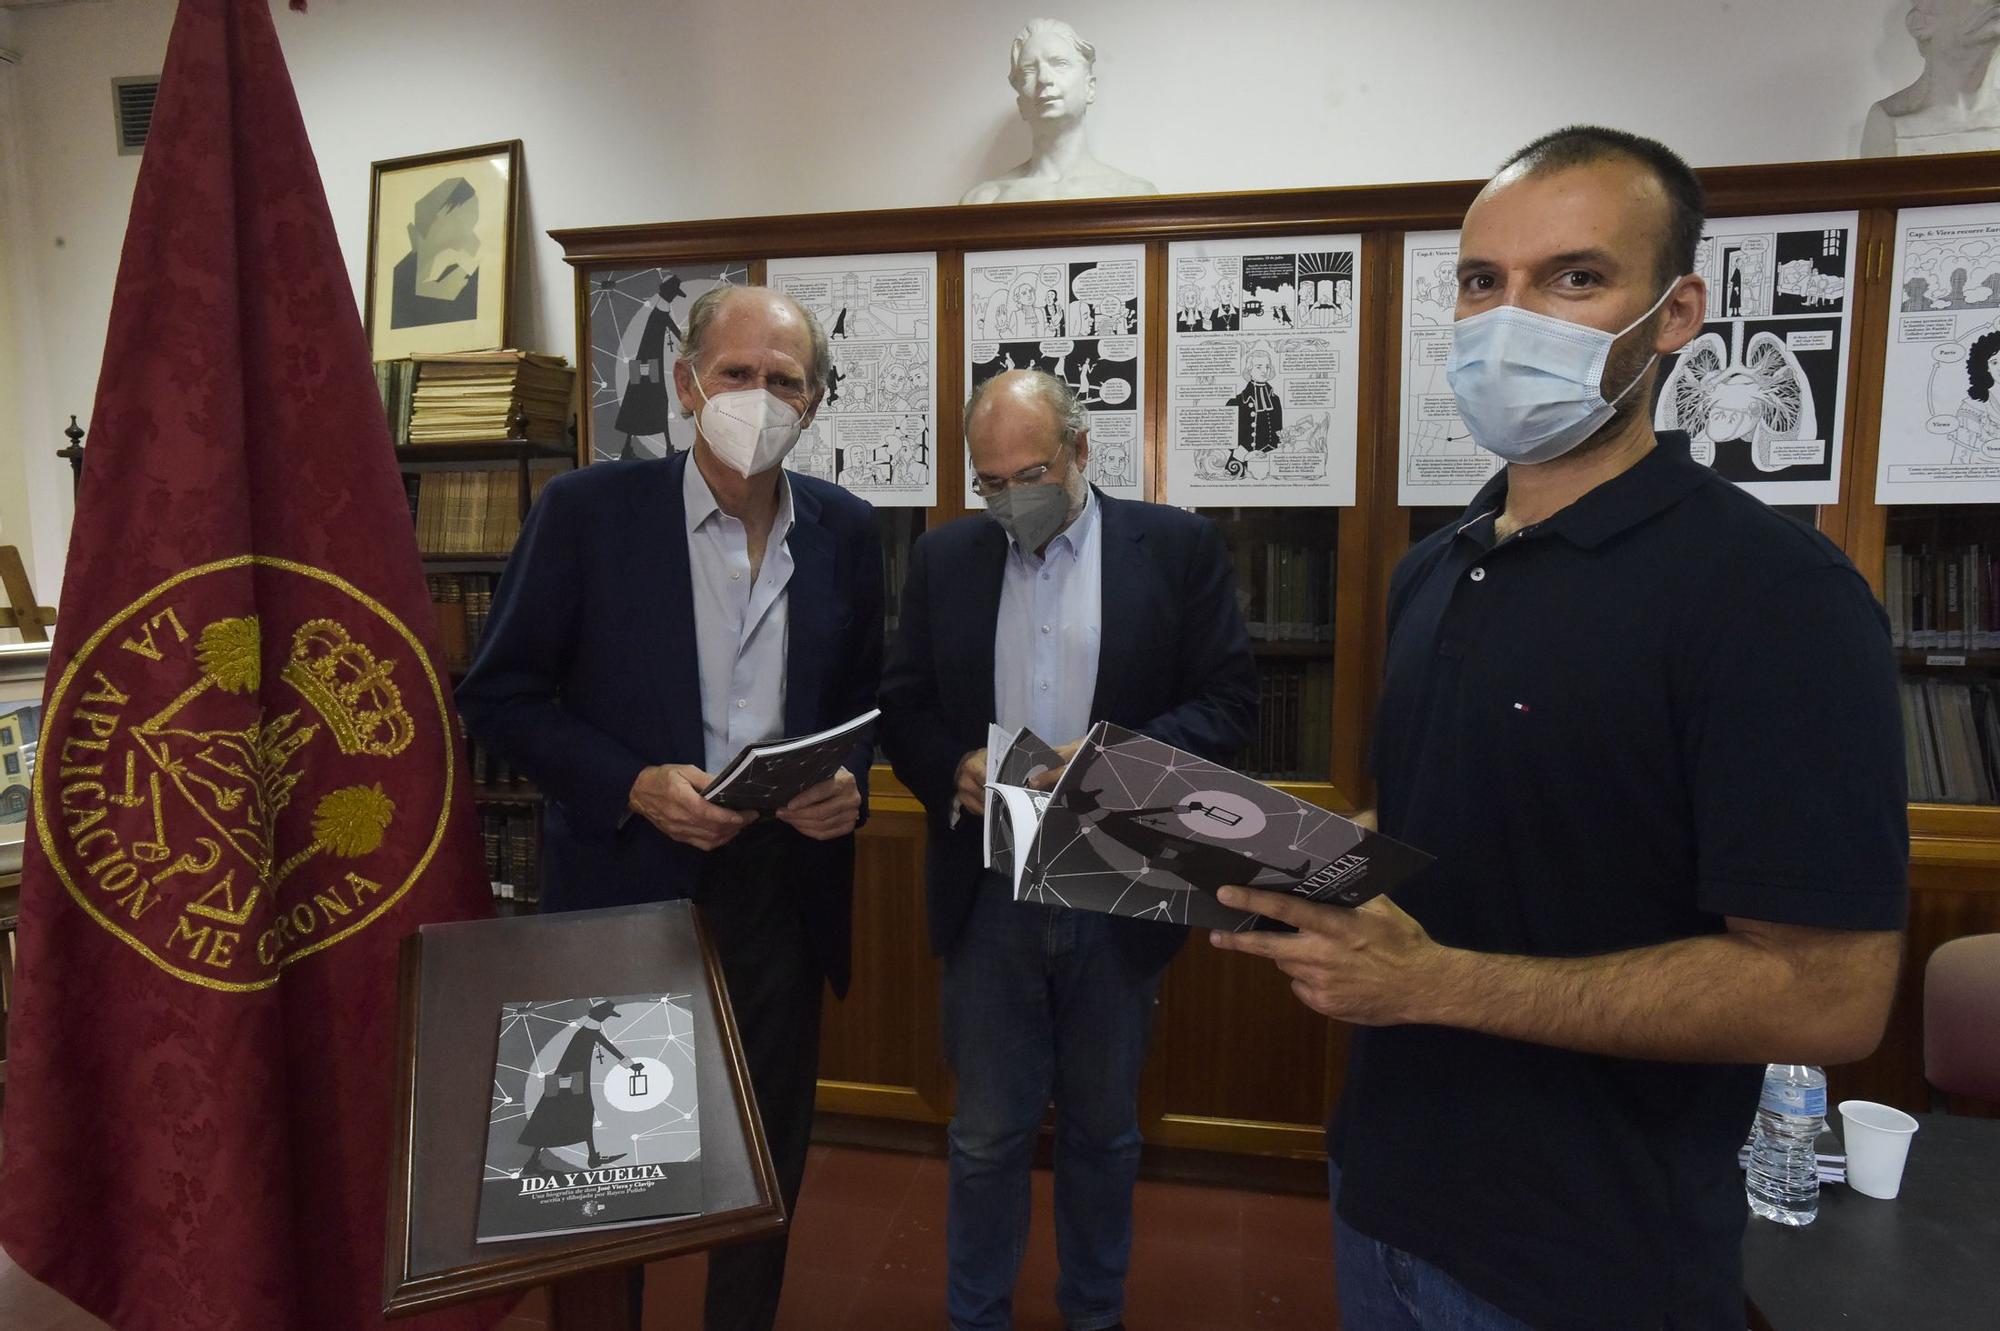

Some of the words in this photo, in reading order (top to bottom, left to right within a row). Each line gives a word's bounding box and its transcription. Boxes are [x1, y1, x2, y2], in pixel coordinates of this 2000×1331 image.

[119, 606, 190, 662] LA
[60, 670, 162, 920] APLICACION
[1293, 885, 1311, 894] Y
[1302, 854, 1366, 887] VUELTA
[164, 915, 240, 968] ME
[257, 871, 383, 966] CRONA
[520, 1176, 560, 1193] IDA
[564, 1173, 580, 1187] Y
[582, 1164, 666, 1185] VUELTA
[610, 1183, 629, 1191] Viera
[633, 1180, 656, 1189] Clavijo
